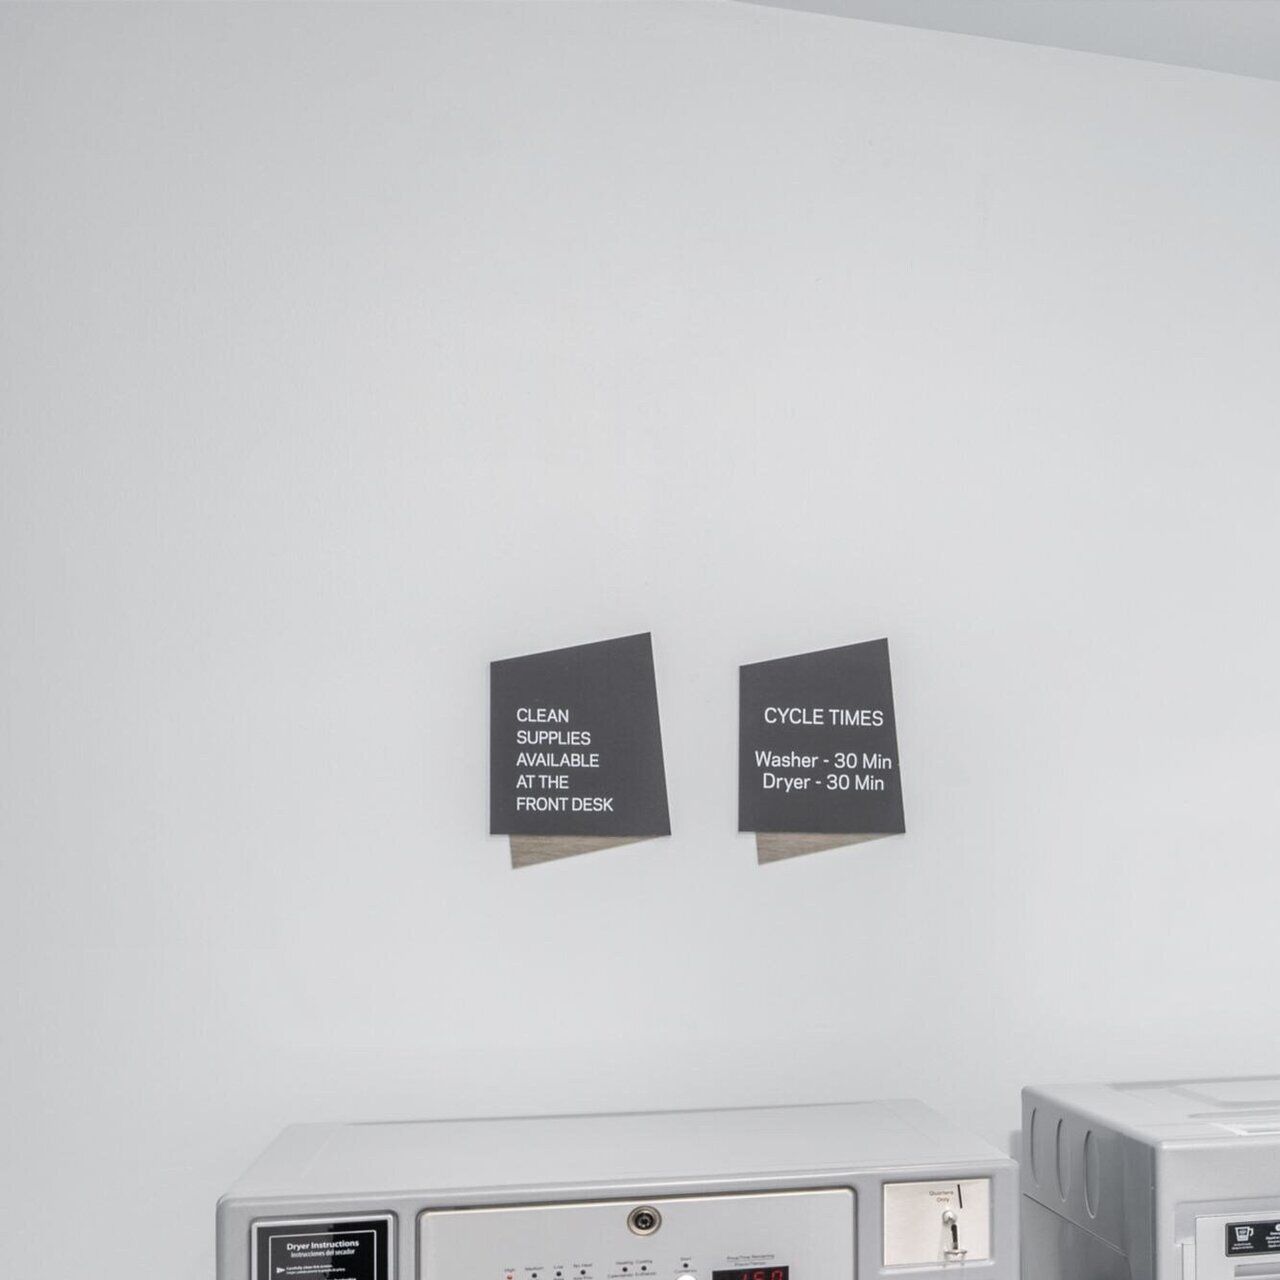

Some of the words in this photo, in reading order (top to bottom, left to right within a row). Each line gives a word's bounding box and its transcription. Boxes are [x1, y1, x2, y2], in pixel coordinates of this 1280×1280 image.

[516, 708, 569, 723] CLEAN
[764, 707, 824, 725] CYCLE
[828, 708, 884, 726] TIMES
[516, 730, 591, 745] SUPPLIES
[516, 752, 600, 767] AVAILABLE
[755, 750, 819, 768] Washer
[834, 753, 858, 769] 30
[862, 753, 892, 769] Min
[516, 774, 536, 789] AT
[538, 775, 570, 789] THE
[763, 772, 811, 793] Dryer
[826, 774, 850, 790] 30
[854, 774, 884, 791] Min
[516, 797, 569, 811] FRONT
[571, 797, 614, 812] DESK
[286, 1242, 310, 1251] Dryer
[311, 1240, 359, 1249] Instructions
